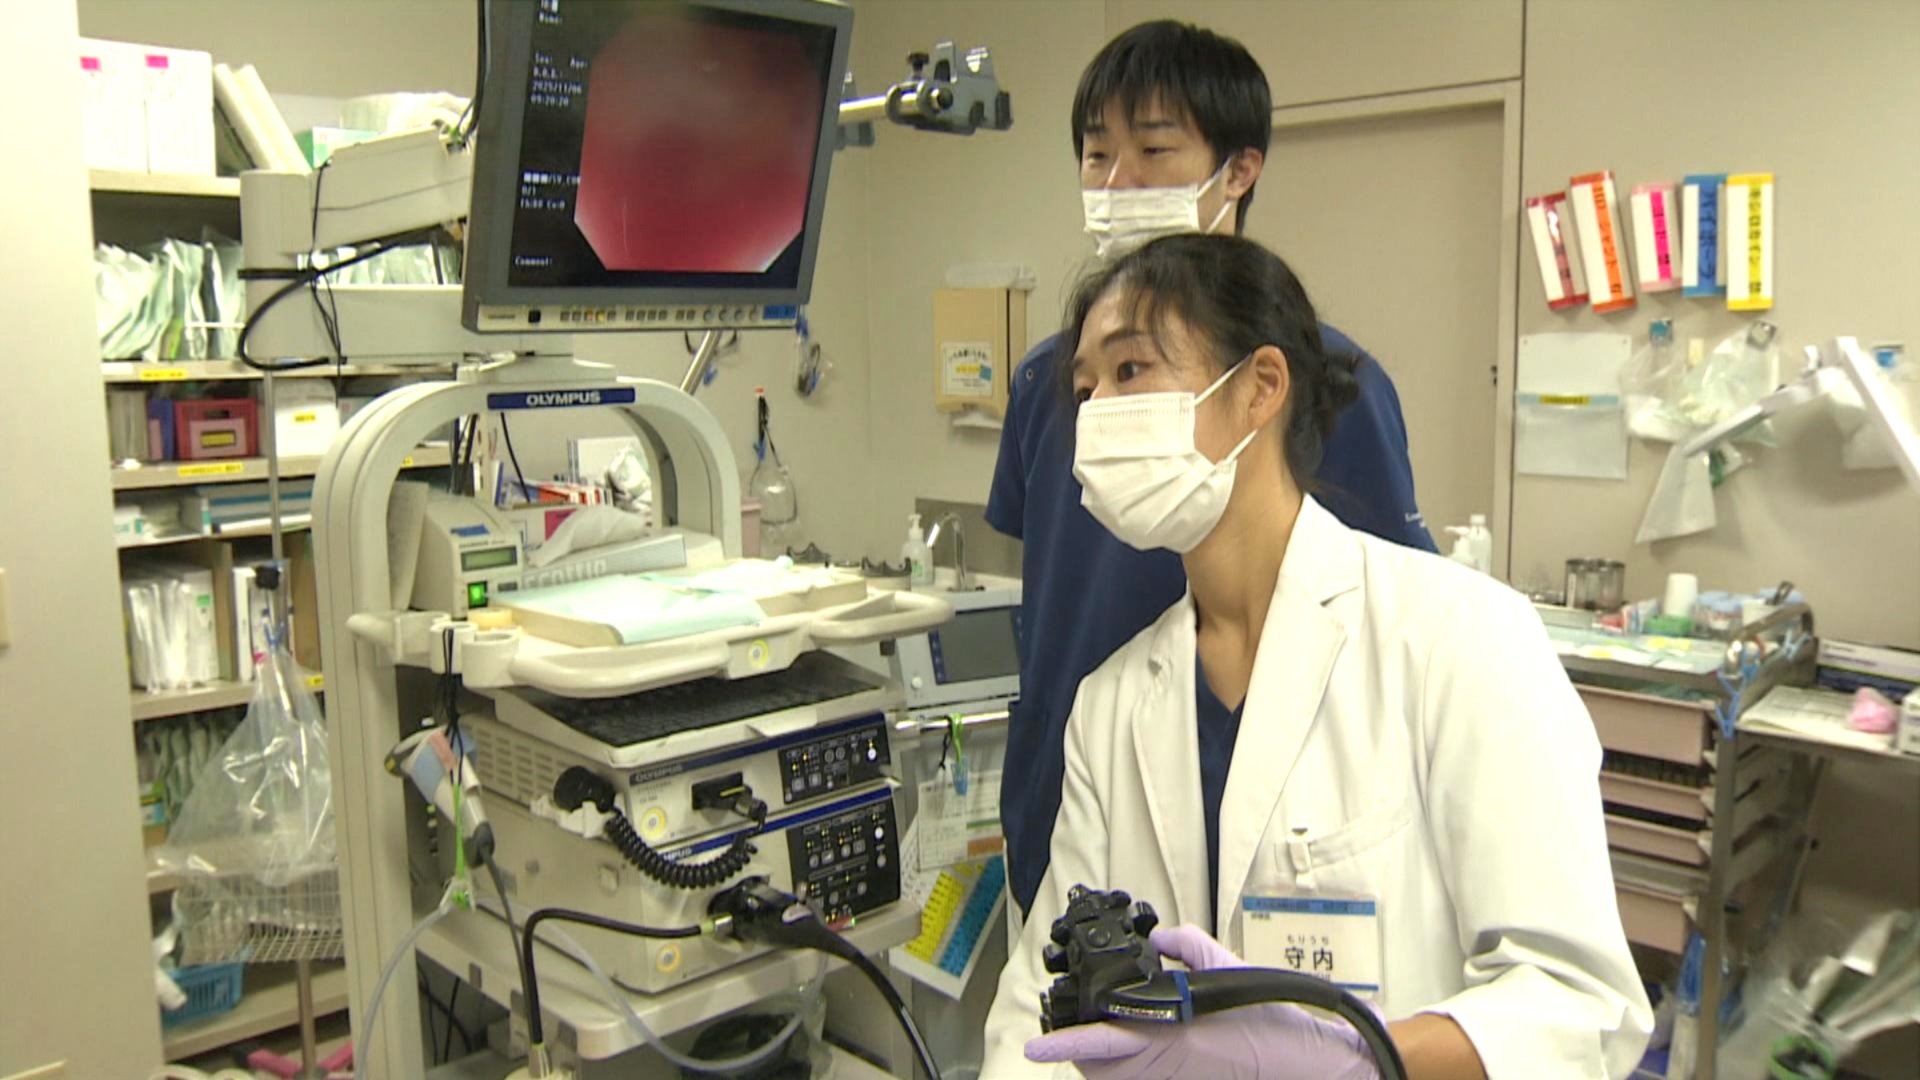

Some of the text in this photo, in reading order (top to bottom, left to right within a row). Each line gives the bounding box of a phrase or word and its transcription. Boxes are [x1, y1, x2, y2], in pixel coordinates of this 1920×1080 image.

[526, 392, 600, 406] OLYMPUS
[1287, 934, 1329, 946] もりうち
[1285, 947, 1334, 971] 守内
